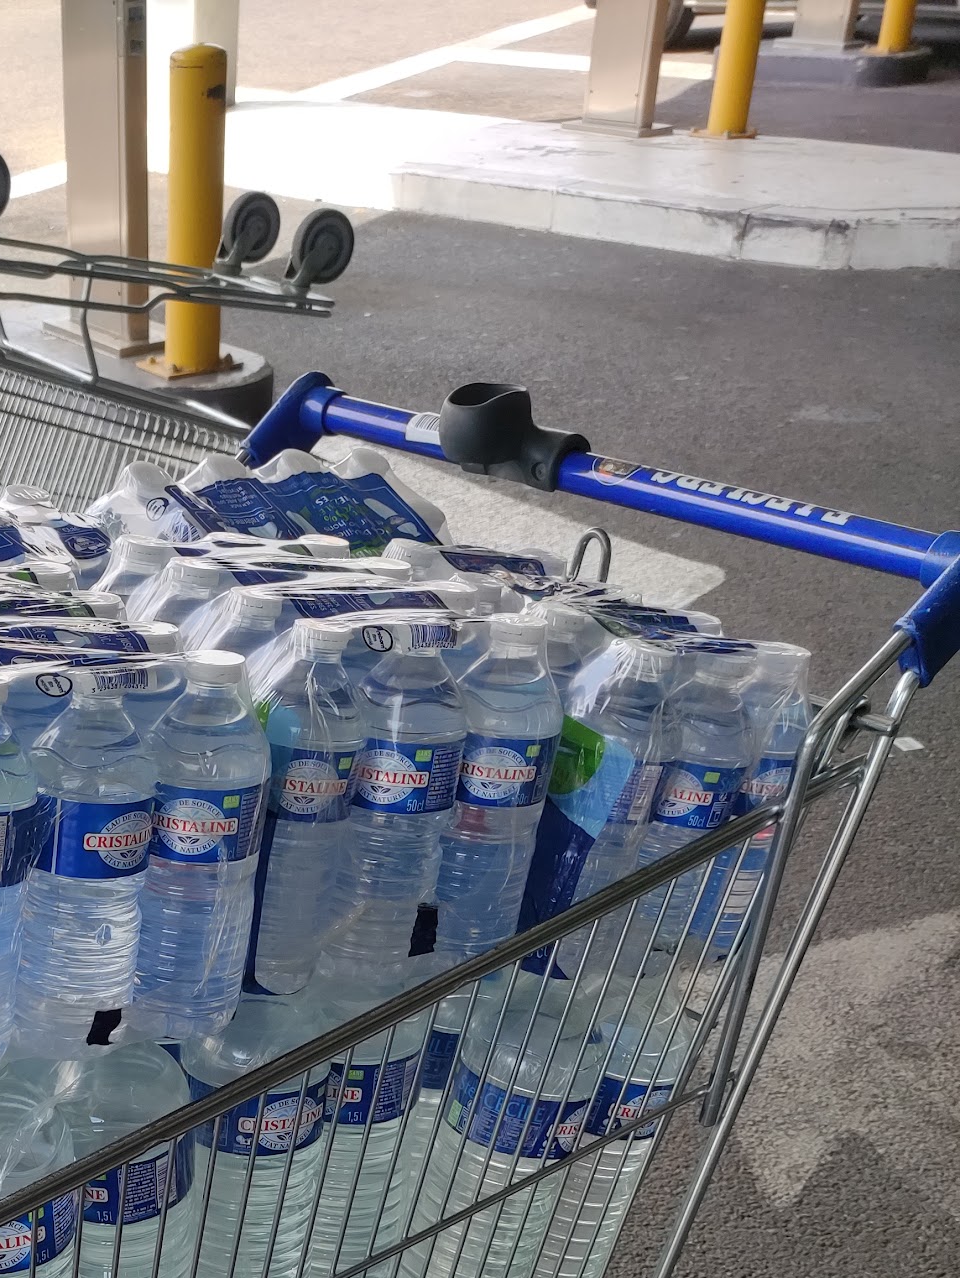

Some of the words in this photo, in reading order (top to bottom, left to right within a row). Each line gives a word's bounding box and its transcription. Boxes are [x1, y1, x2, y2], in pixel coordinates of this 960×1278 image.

[360, 766, 427, 785] ISTALINE
[460, 762, 535, 780] RISTALINE
[282, 778, 346, 794] ISTALINE
[670, 787, 712, 804] ALINE
[191, 800, 221, 818] SOURCE
[406, 799, 425, 812] 50cl
[105, 819, 121, 833] EAU
[122, 813, 132, 822] DE
[687, 815, 705, 828] 50cl
[85, 829, 152, 849] CRISTALIN
[103, 854, 121, 868] ETAT
[96, 1210, 113, 1222] 1,5l
